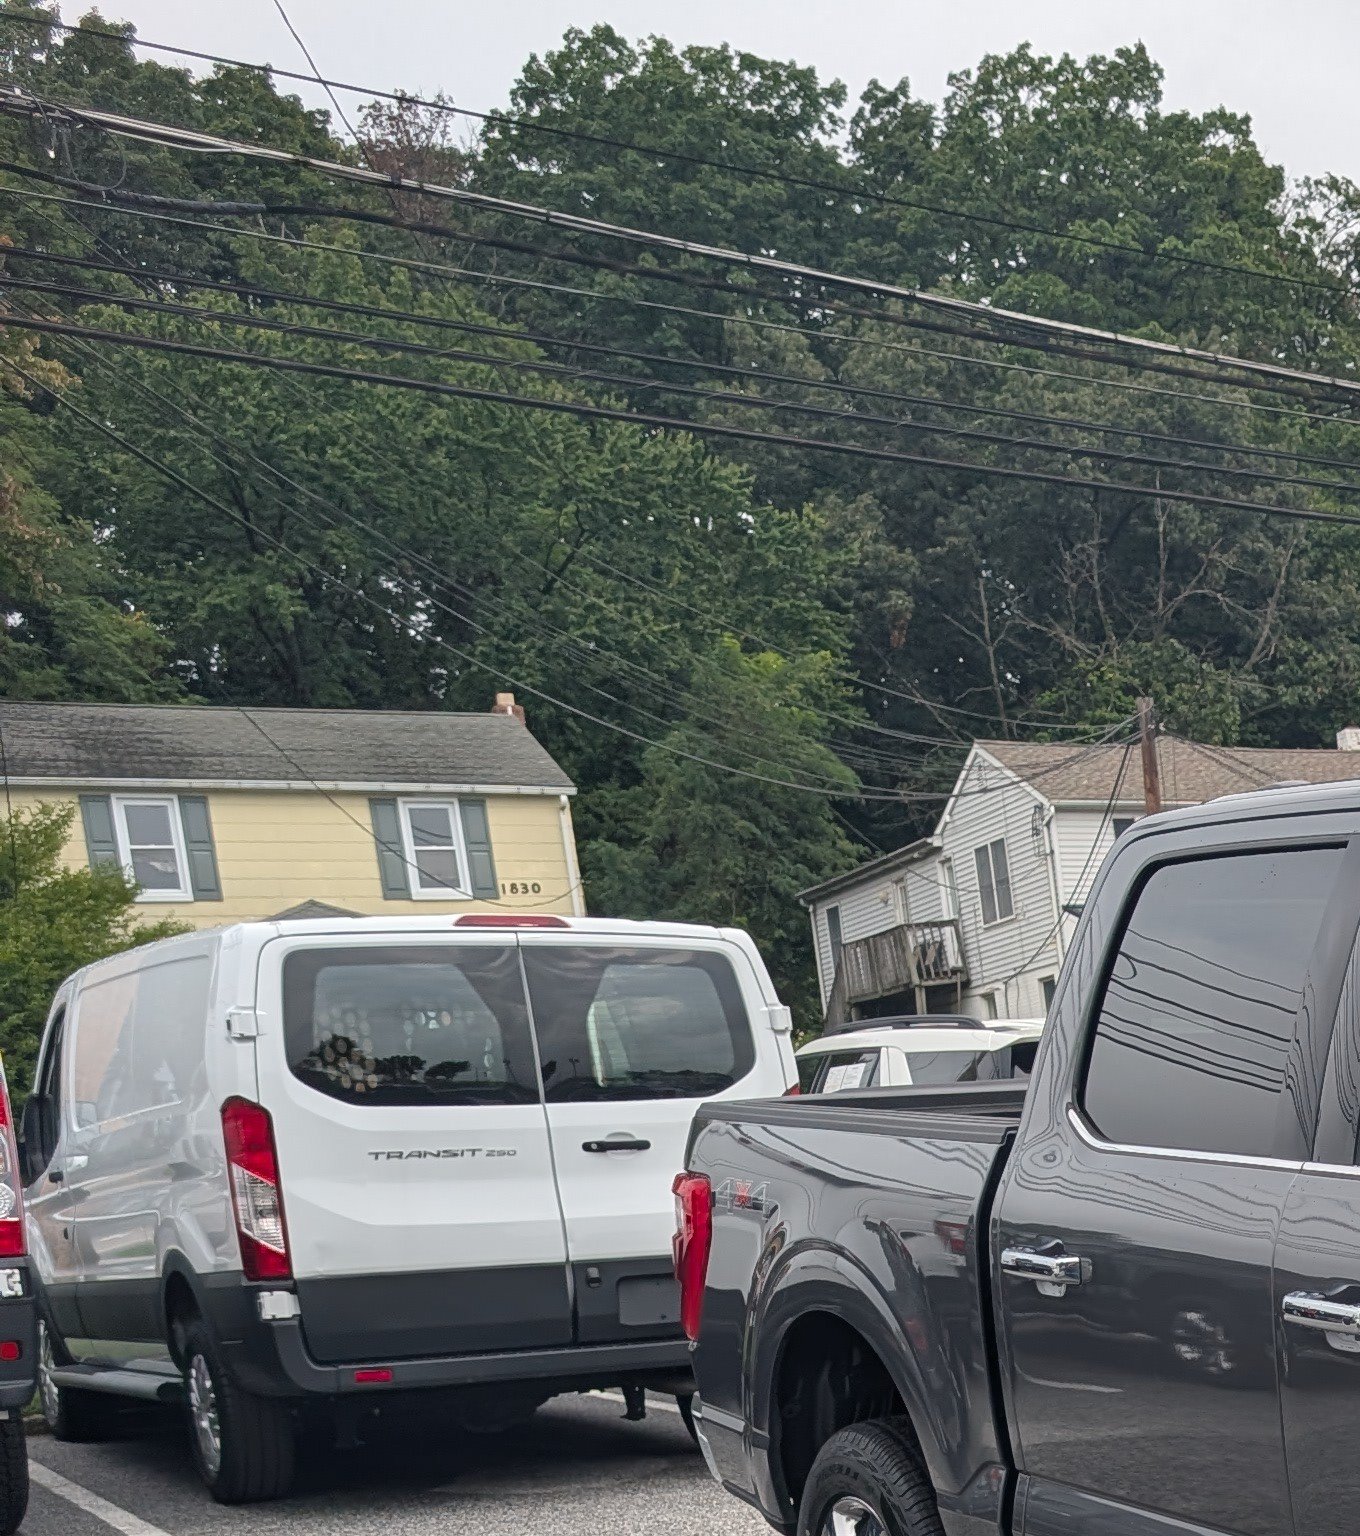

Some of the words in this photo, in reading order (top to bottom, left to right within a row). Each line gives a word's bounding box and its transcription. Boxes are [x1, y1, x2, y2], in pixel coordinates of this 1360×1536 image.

[501, 882, 542, 895] 1830
[368, 1147, 483, 1161] TRANSIT
[485, 1149, 517, 1158] 250
